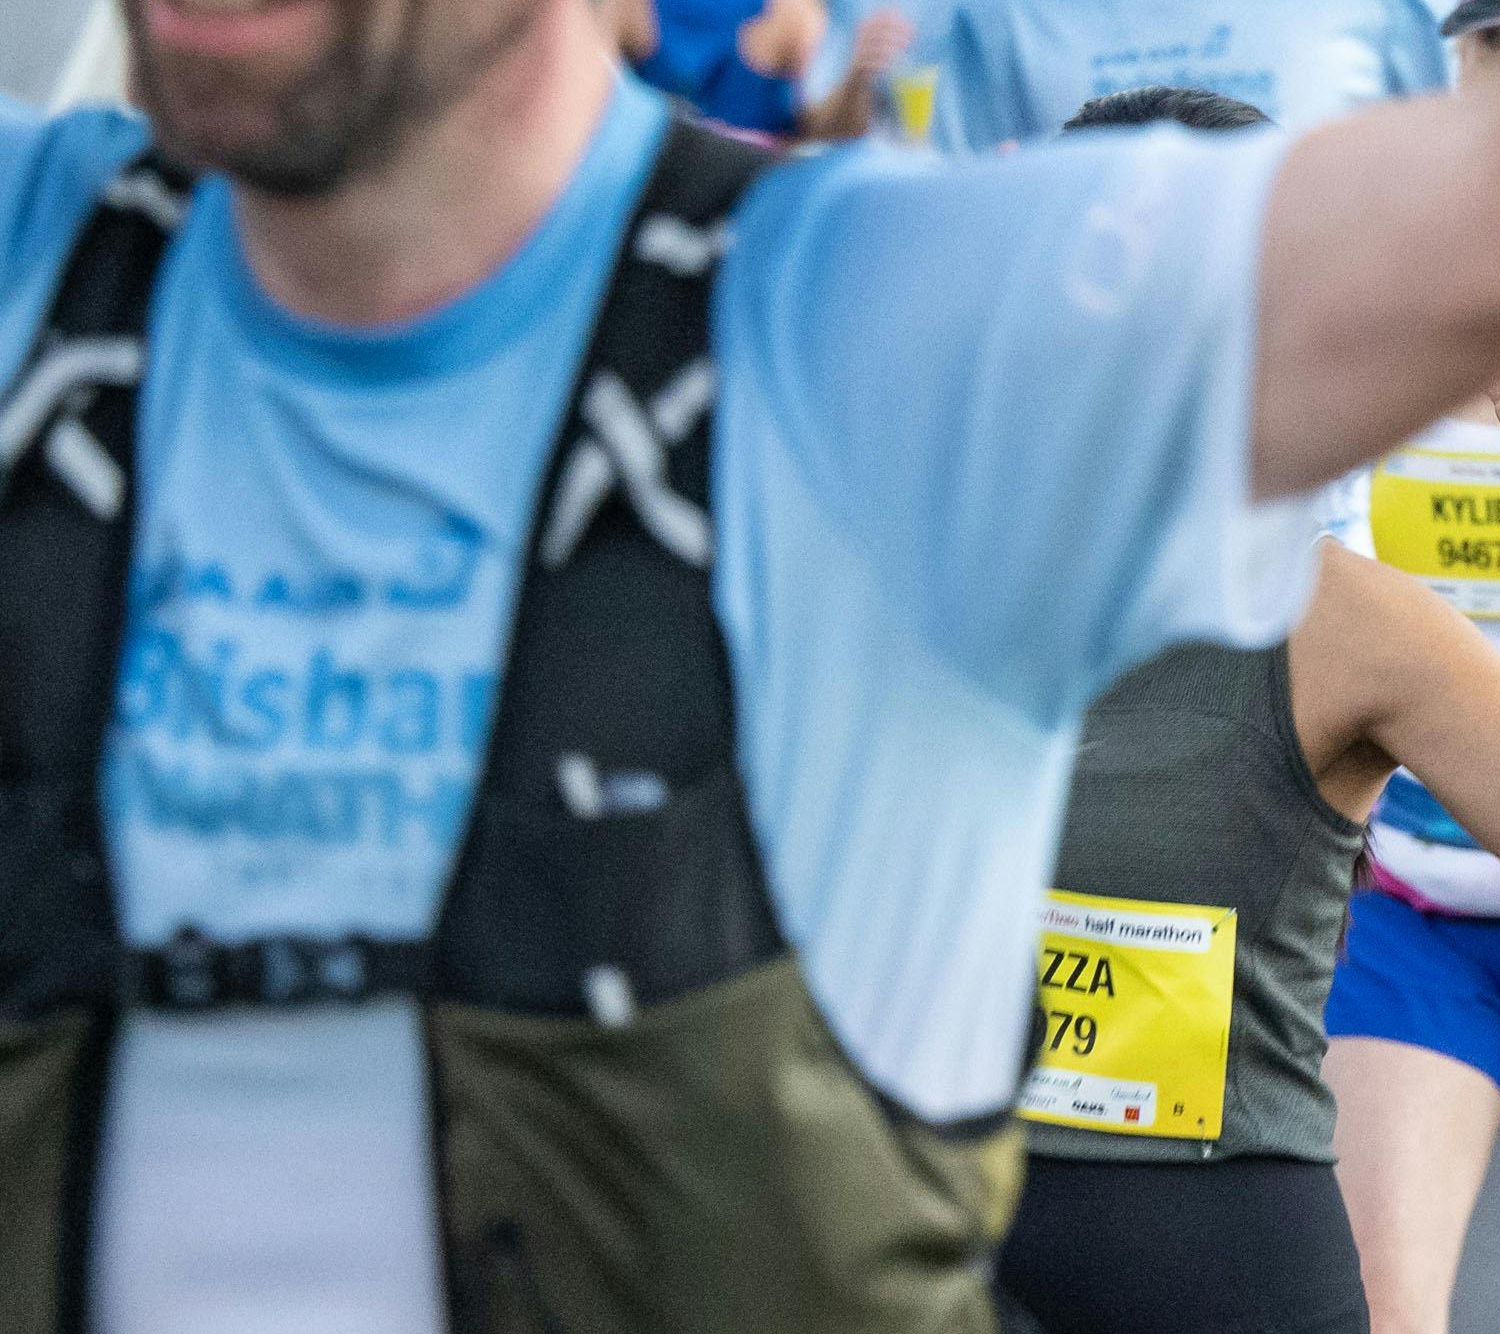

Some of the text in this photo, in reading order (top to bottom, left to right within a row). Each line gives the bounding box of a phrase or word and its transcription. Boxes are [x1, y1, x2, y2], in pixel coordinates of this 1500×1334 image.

[1085, 914, 1116, 935] half
[1119, 920, 1203, 945] marathon
[1041, 947, 1115, 998] ZZA
